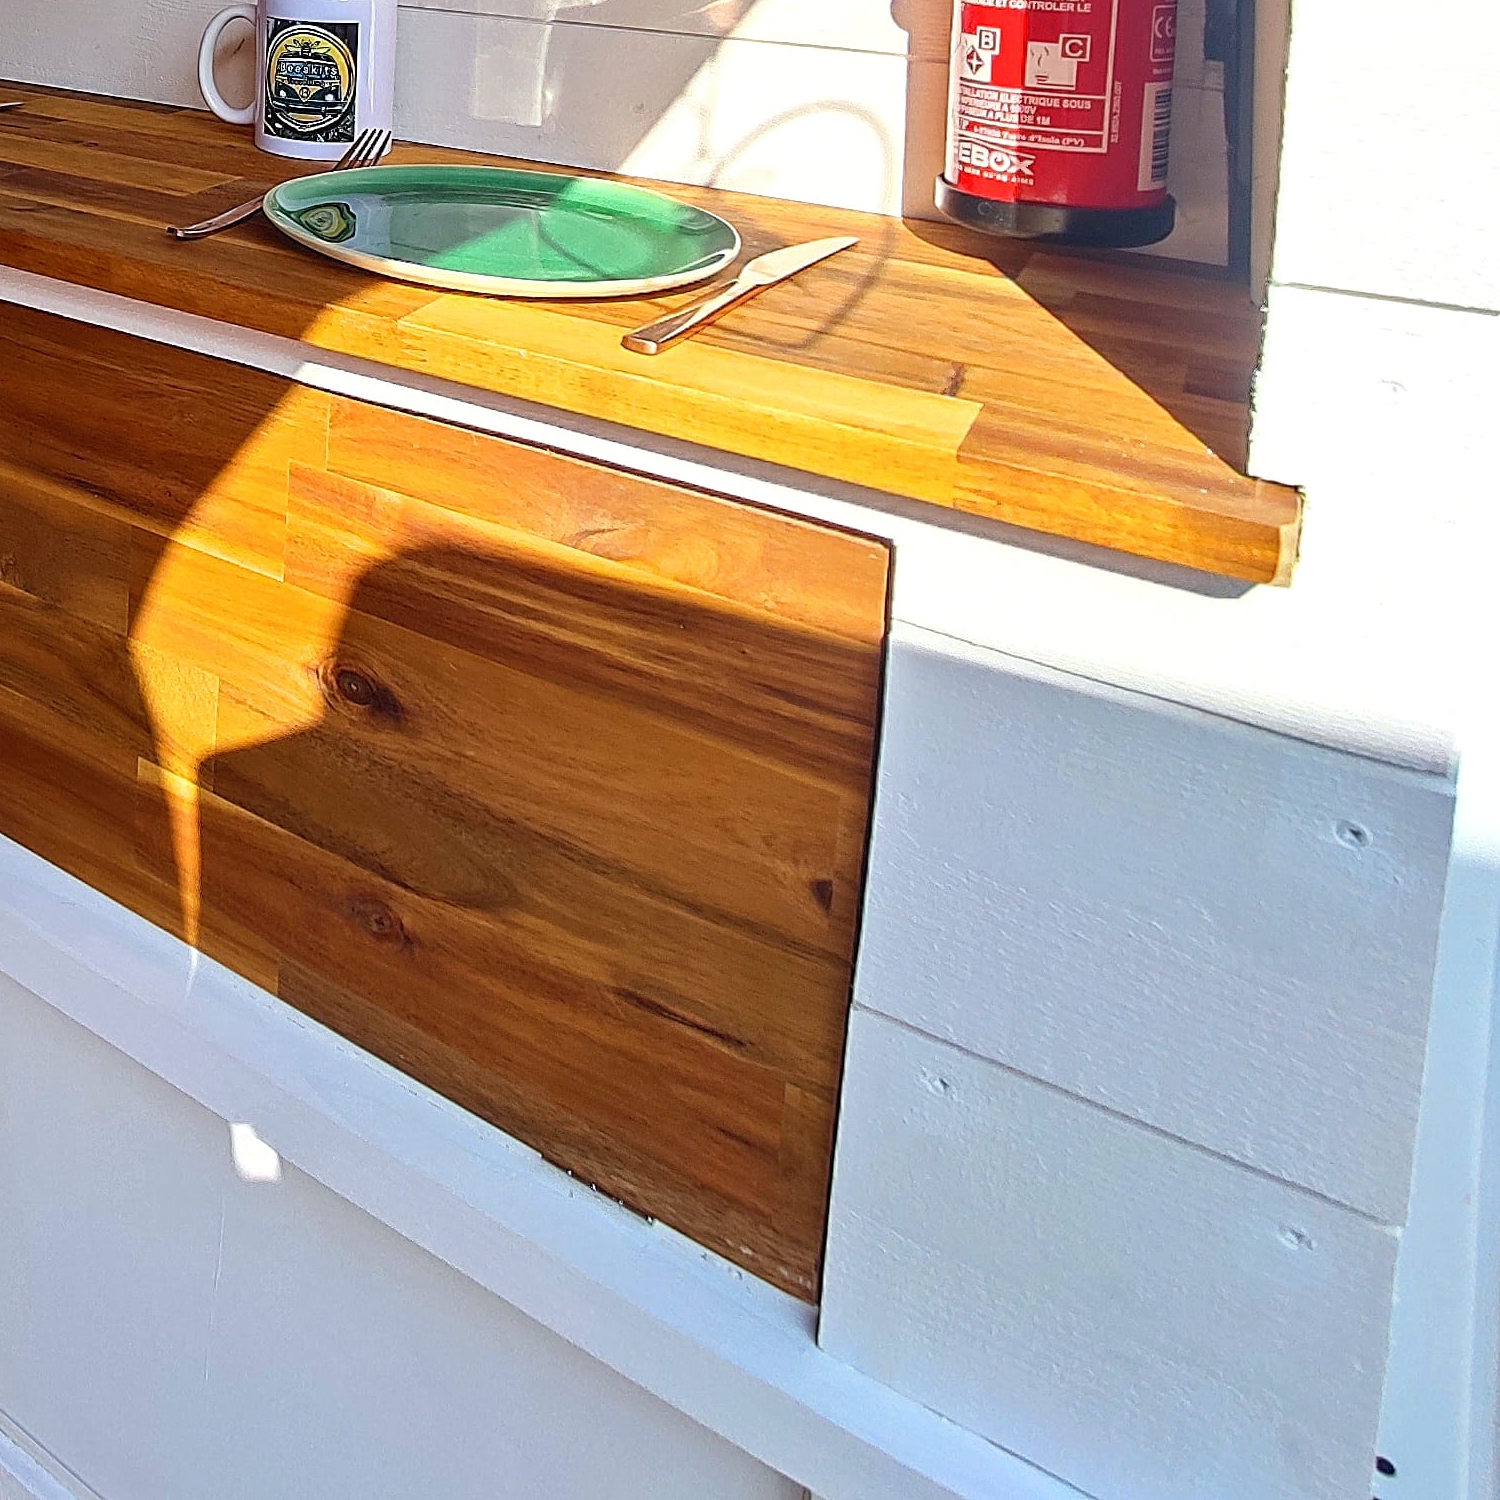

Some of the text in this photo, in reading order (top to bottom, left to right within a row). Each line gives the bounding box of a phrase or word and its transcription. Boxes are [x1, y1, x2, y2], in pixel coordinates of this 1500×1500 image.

[1009, 0, 1075, 13] CONTROLER
[1077, 3, 1092, 13] LE
[982, 31, 994, 49] B
[1065, 39, 1084, 57] C
[1000, 93, 1060, 109] ELECTRIQUE
[1062, 99, 1091, 110] SOUS
[1020, 115, 1034, 124] DE
[1036, 116, 1051, 126] 1M
[1061, 136, 1085, 148] (PV)
